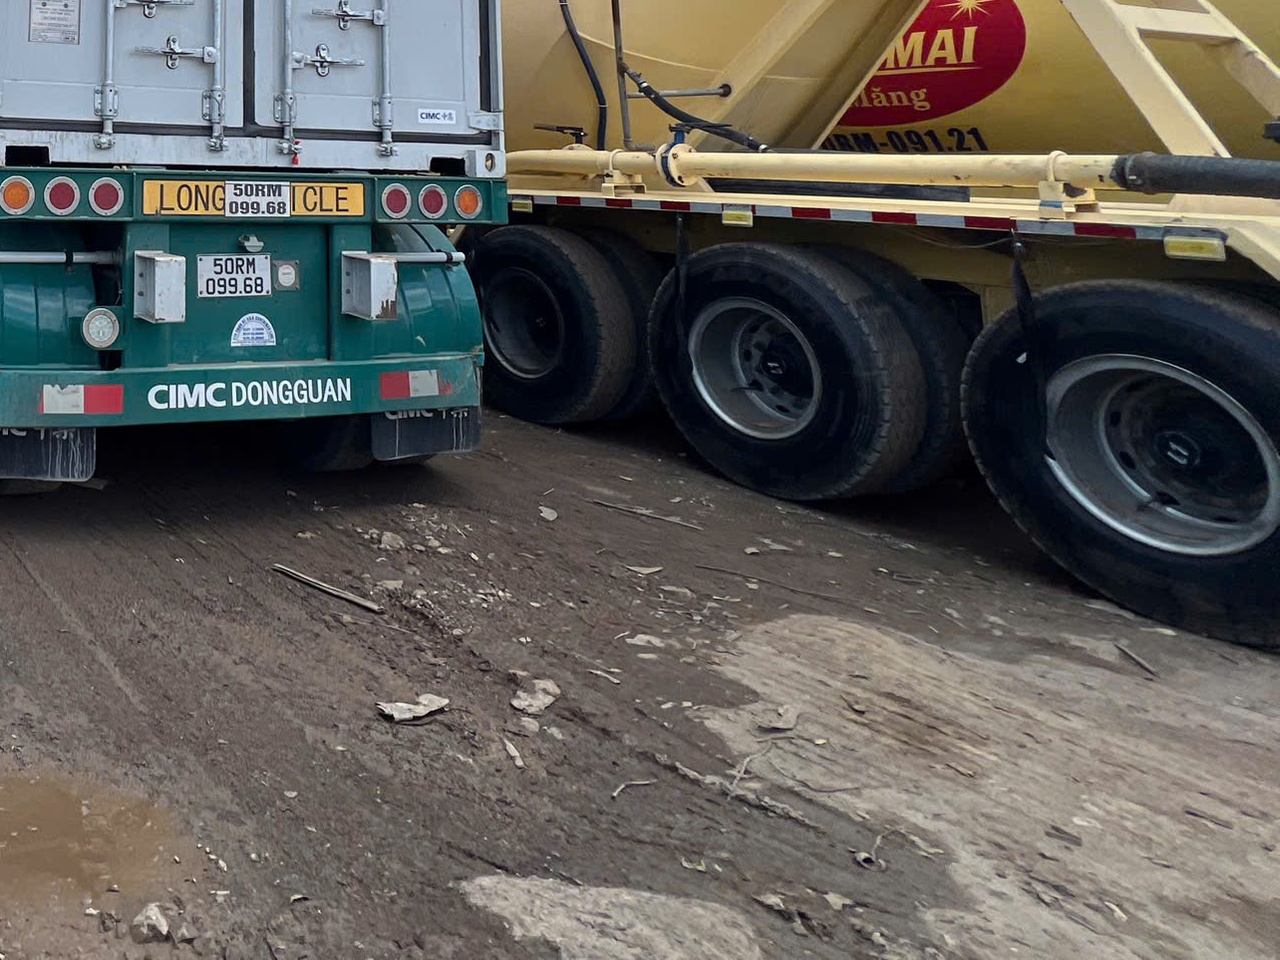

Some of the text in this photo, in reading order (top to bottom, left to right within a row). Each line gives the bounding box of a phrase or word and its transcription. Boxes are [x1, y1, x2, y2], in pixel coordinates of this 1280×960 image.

[877, 26, 979, 69] MAI
[159, 184, 226, 212] LONG
[233, 183, 282, 197] 50RM
[228, 201, 287, 215] 099.68
[213, 258, 256, 275] 50RM
[206, 277, 264, 295] 099.68
[147, 378, 351, 410] CIMC DONGGUAN
